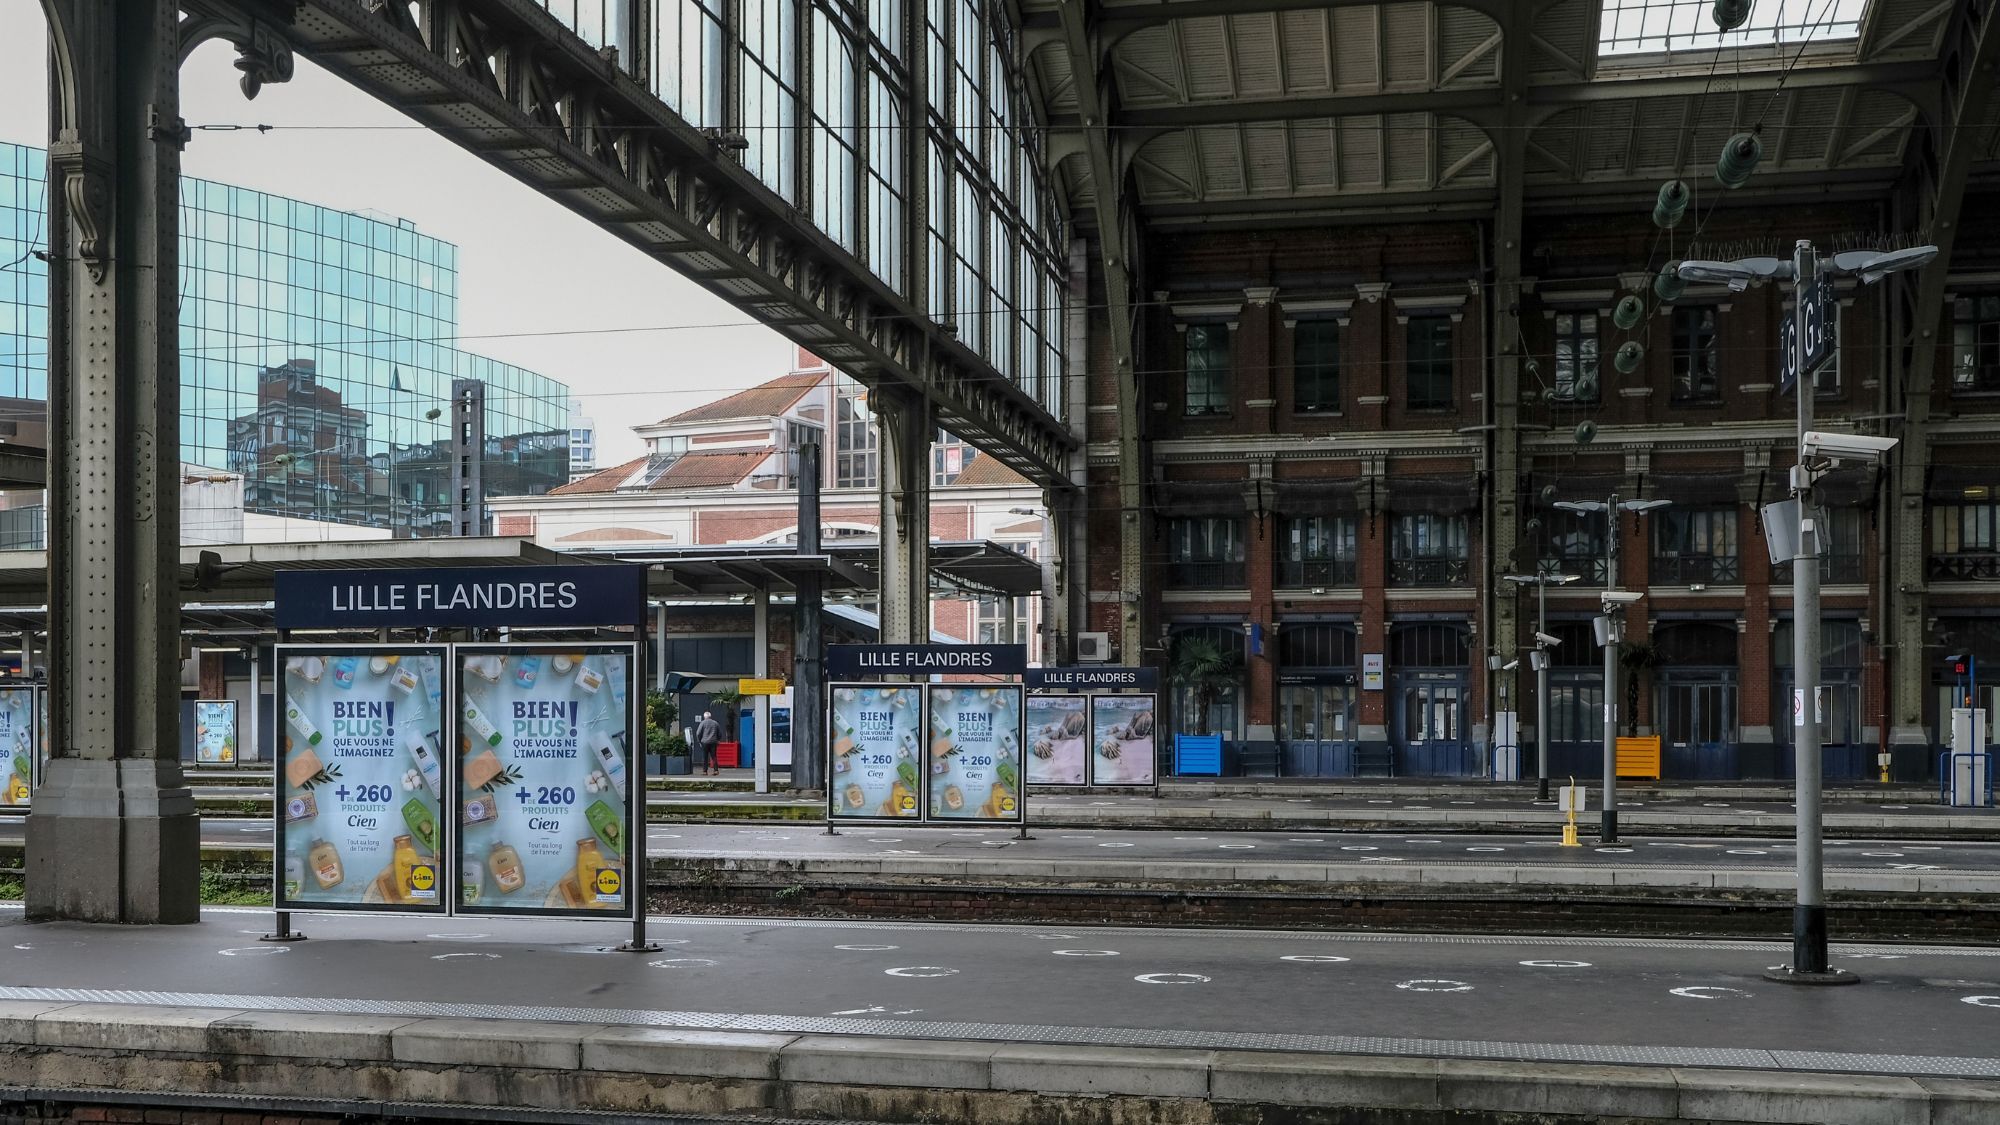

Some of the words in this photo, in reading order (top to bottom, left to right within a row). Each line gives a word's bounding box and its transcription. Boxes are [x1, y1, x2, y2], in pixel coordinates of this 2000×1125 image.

[1805, 302, 1814, 357] G
[1787, 324, 1795, 376] G
[332, 585, 406, 610] LILLE
[417, 582, 577, 610] FLANDRES
[859, 652, 900, 666] LILLE
[905, 652, 992, 666] FLANDRES
[1044, 673, 1072, 683] LILLE
[1076, 672, 1136, 683] FLANDRES
[333, 702, 382, 718] BIEN
[512, 701, 565, 718] BIEN
[860, 712, 887, 721] BIEN
[958, 712, 986, 721] BIEN
[333, 720, 383, 736] PLUS
[512, 720, 566, 737] PLUS
[860, 722, 887, 730] PLUS
[958, 722, 986, 731] PLUS
[333, 738, 352, 748] QUE
[513, 739, 532, 748] QUE
[535, 739, 562, 747] VOUS
[564, 739, 577, 747] NE
[0, 750, 9, 758] 60
[334, 748, 394, 757] L'IMAGINEZ
[514, 750, 577, 758] L'IMAGINEZ
[872, 755, 892, 764] 260
[971, 756, 992, 765] 260
[356, 784, 392, 802] 260
[538, 786, 576, 804] 260
[347, 814, 377, 828] Cien
[528, 817, 559, 830] Cien
